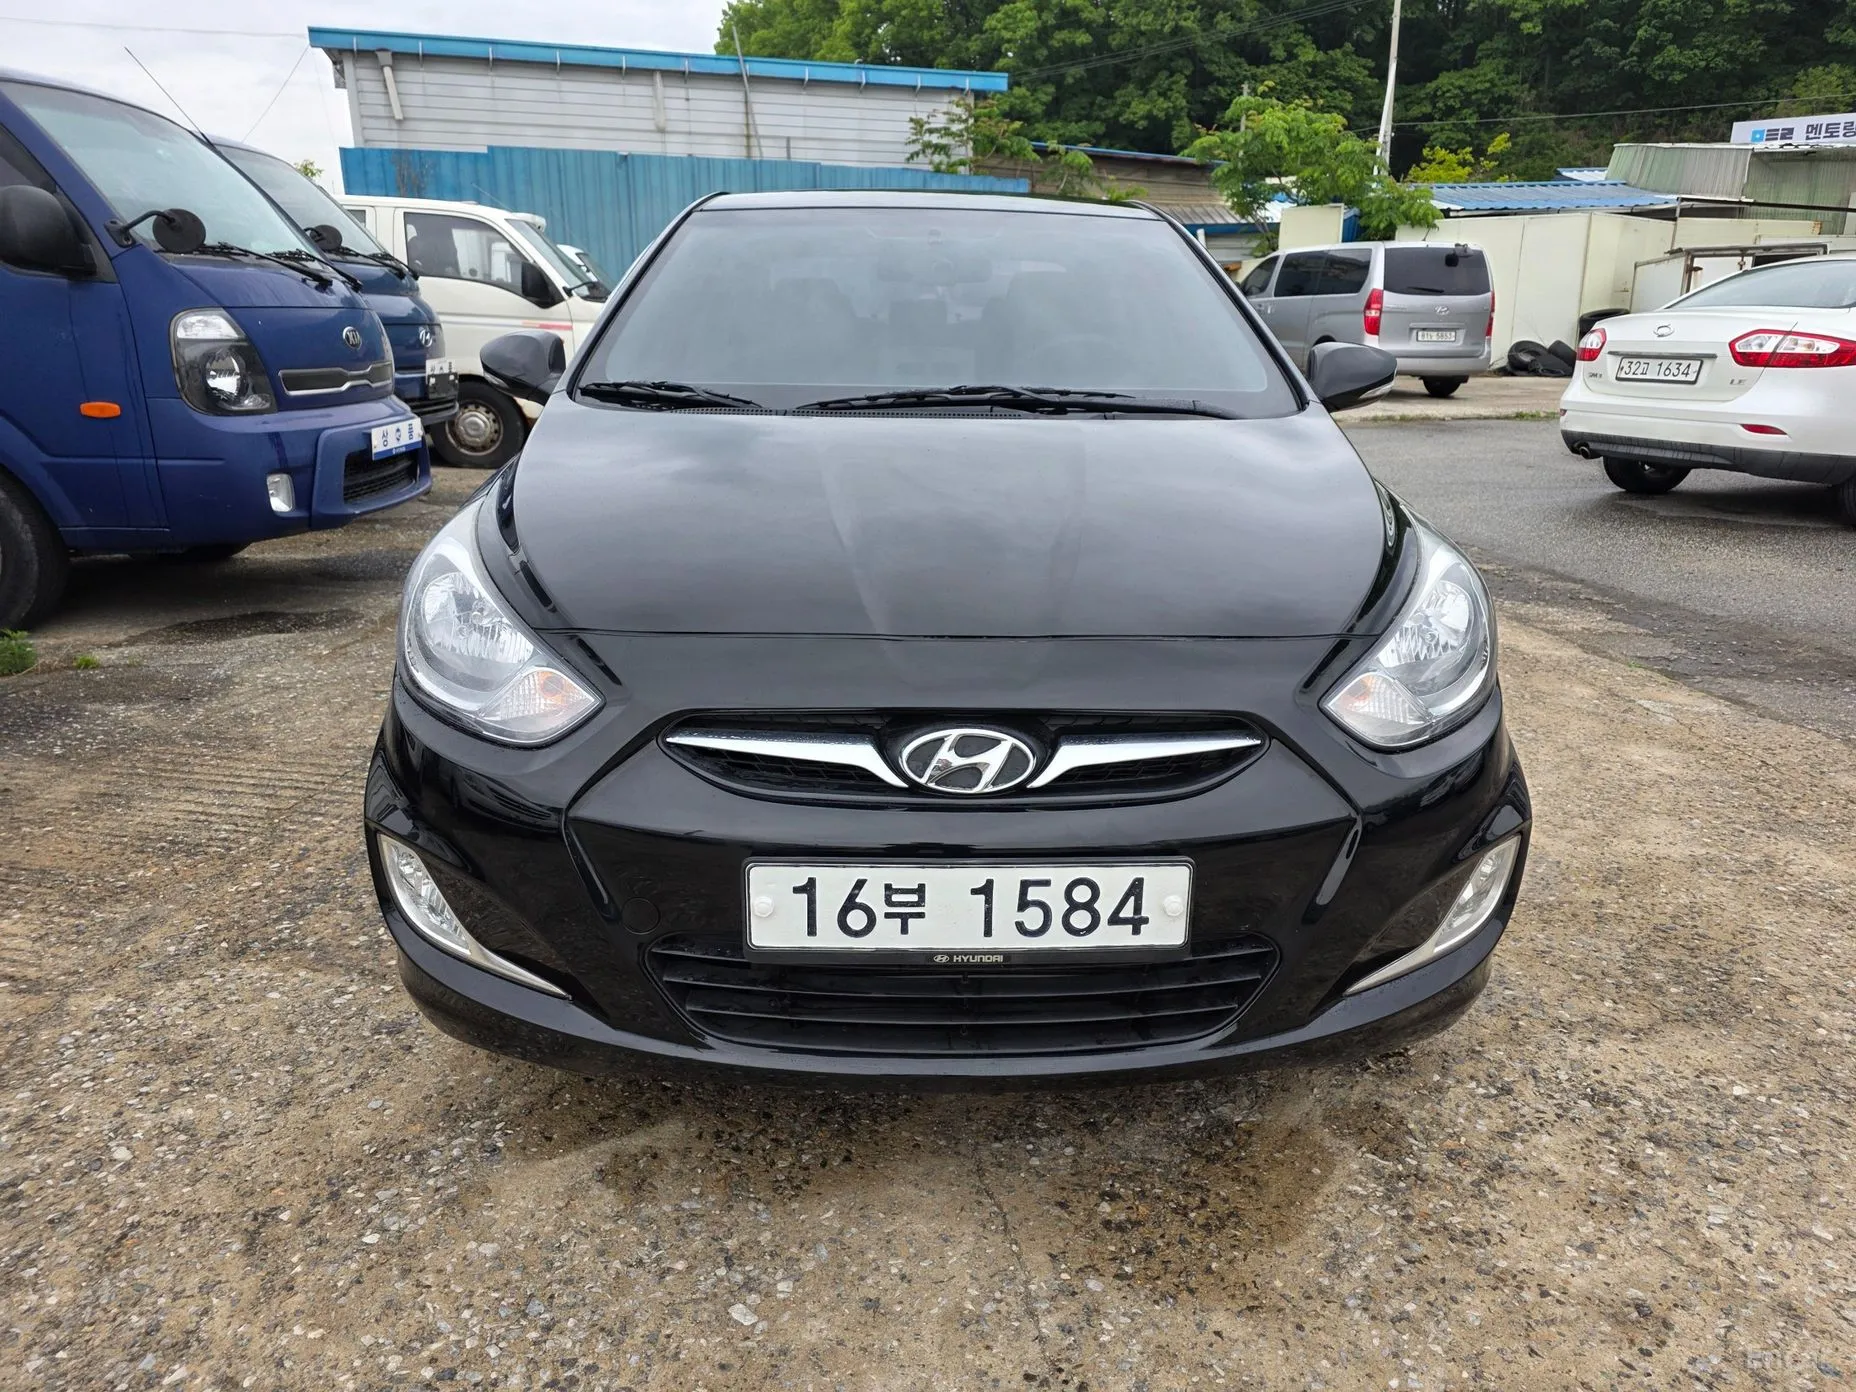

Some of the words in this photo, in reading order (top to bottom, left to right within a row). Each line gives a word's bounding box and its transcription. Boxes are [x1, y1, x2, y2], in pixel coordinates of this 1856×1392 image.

[1657, 361, 1692, 378] 1634
[792, 876, 927, 938] 16부
[969, 876, 1151, 938] 1584
[953, 954, 1004, 963] HYUNDAI
